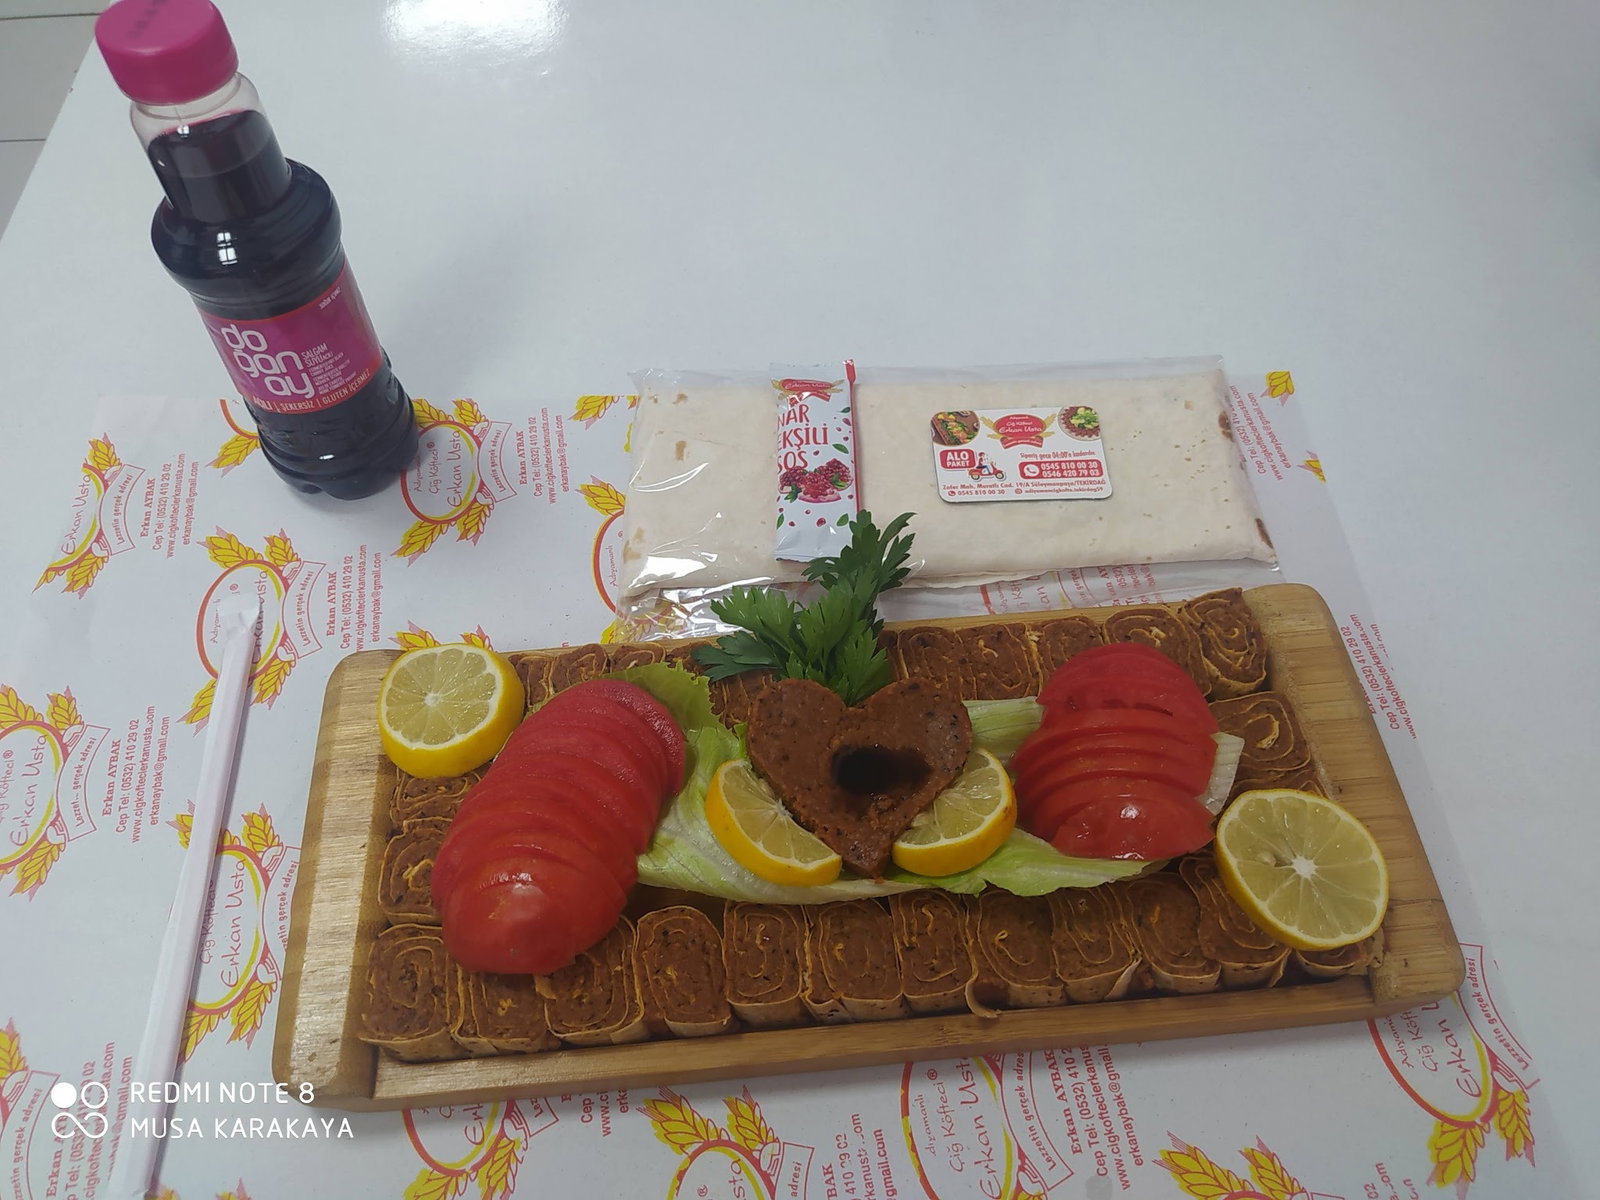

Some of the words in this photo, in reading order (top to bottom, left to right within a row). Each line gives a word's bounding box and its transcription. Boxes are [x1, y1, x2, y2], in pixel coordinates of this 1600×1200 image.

[264, 372, 315, 398] ay
[322, 387, 349, 405] GLUTEN
[528, 416, 536, 425] 02
[528, 425, 537, 434] 29
[446, 430, 462, 461] Usta
[515, 431, 526, 458] AYBAK
[529, 434, 538, 446] 410
[1235, 425, 1254, 446] (0532)
[162, 463, 172, 472] 02
[530, 447, 542, 468] (0532)
[946, 451, 969, 461] ALO
[946, 460, 970, 468] PAKET
[1060, 462, 1075, 470] 810
[1076, 461, 1087, 469] 00
[1088, 461, 1098, 469] 30
[1256, 460, 1267, 474] Cep
[161, 472, 170, 482] 29
[446, 465, 463, 507] Erkan
[518, 460, 528, 485] Erkan
[531, 468, 541, 482] Tel:
[1042, 470, 1061, 478] 0546
[1062, 469, 1077, 477] 420
[1079, 469, 1088, 477] 79
[72, 473, 92, 508] Usta
[144, 478, 156, 508] AYBAK
[159, 482, 169, 497] 410
[533, 482, 544, 497] Cep
[156, 495, 168, 518] (0532)
[61, 509, 84, 555] Erkan
[140, 510, 152, 537] Erkan
[153, 519, 164, 534] Tel:
[152, 535, 164, 551] Cep
[343, 565, 353, 575] 29
[344, 555, 353, 565] 02
[327, 571, 338, 607] AYBAK
[342, 575, 352, 589] 410
[341, 590, 354, 615] (0532)
[326, 607, 337, 637] Erkan
[341, 615, 351, 632] Tel:
[1340, 625, 1352, 637] 02
[340, 632, 353, 649] Cep
[1346, 638, 1358, 649] 29
[1352, 649, 1366, 665] 410
[1361, 665, 1383, 692] (0532)
[1376, 693, 1390, 710] Tel:
[129, 719, 140, 732] 02
[1386, 711, 1400, 730] Cep
[127, 732, 138, 744] 29
[21, 734, 48, 777] Usta
[107, 739, 122, 778] AYBAK
[125, 745, 136, 764] 410
[121, 763, 137, 791] (0532)
[149, 716, 170, 826] erkanaybak@gmail.com
[102, 781, 116, 817] Erkan
[118, 792, 131, 812] Tel:
[10, 783, 38, 846] Erkan
[115, 812, 129, 833] Cep
[225, 858, 247, 909] Usta
[281, 860, 300, 888] adresi
[277, 891, 289, 922] gerçek
[220, 915, 242, 988] Erkan
[1465, 957, 1479, 988] adresi
[1471, 991, 1498, 1025] gerçek
[1417, 1044, 1439, 1072] Çiğ
[1437, 1018, 1482, 1098] Erkan
[1492, 1028, 1529, 1071] Lezzetin
[1012, 1052, 1025, 1081] adres
[1043, 1049, 1068, 1103] AYBAK
[1064, 1057, 1080, 1079] 410
[955, 1058, 979, 1105] Ust
[581, 1097, 595, 1124] Cep
[1014, 1085, 1035, 1121] gerçek
[1071, 1082, 1095, 1120] (0532)
[13, 1127, 26, 1163] gerçek
[22, 1087, 43, 1123] adresi
[64, 1165, 81, 1191] Tel:
[82, 1060, 96, 1077] 02
[1063, 1107, 1083, 1155] Erkan
[1084, 1123, 1100, 1148] Tel:
[946, 1142, 965, 1173] Çiğ
[973, 1115, 1002, 1200] Erkan
[1028, 1125, 1057, 1171] Lezzetin
[46, 1149, 63, 1198] Erkan
[1094, 1150, 1109, 1177] Cep
[728, 1159, 746, 1200] sta
[788, 1161, 803, 1198] adresi
[822, 1162, 838, 1199] BAK
[842, 1171, 857, 1195] 410
